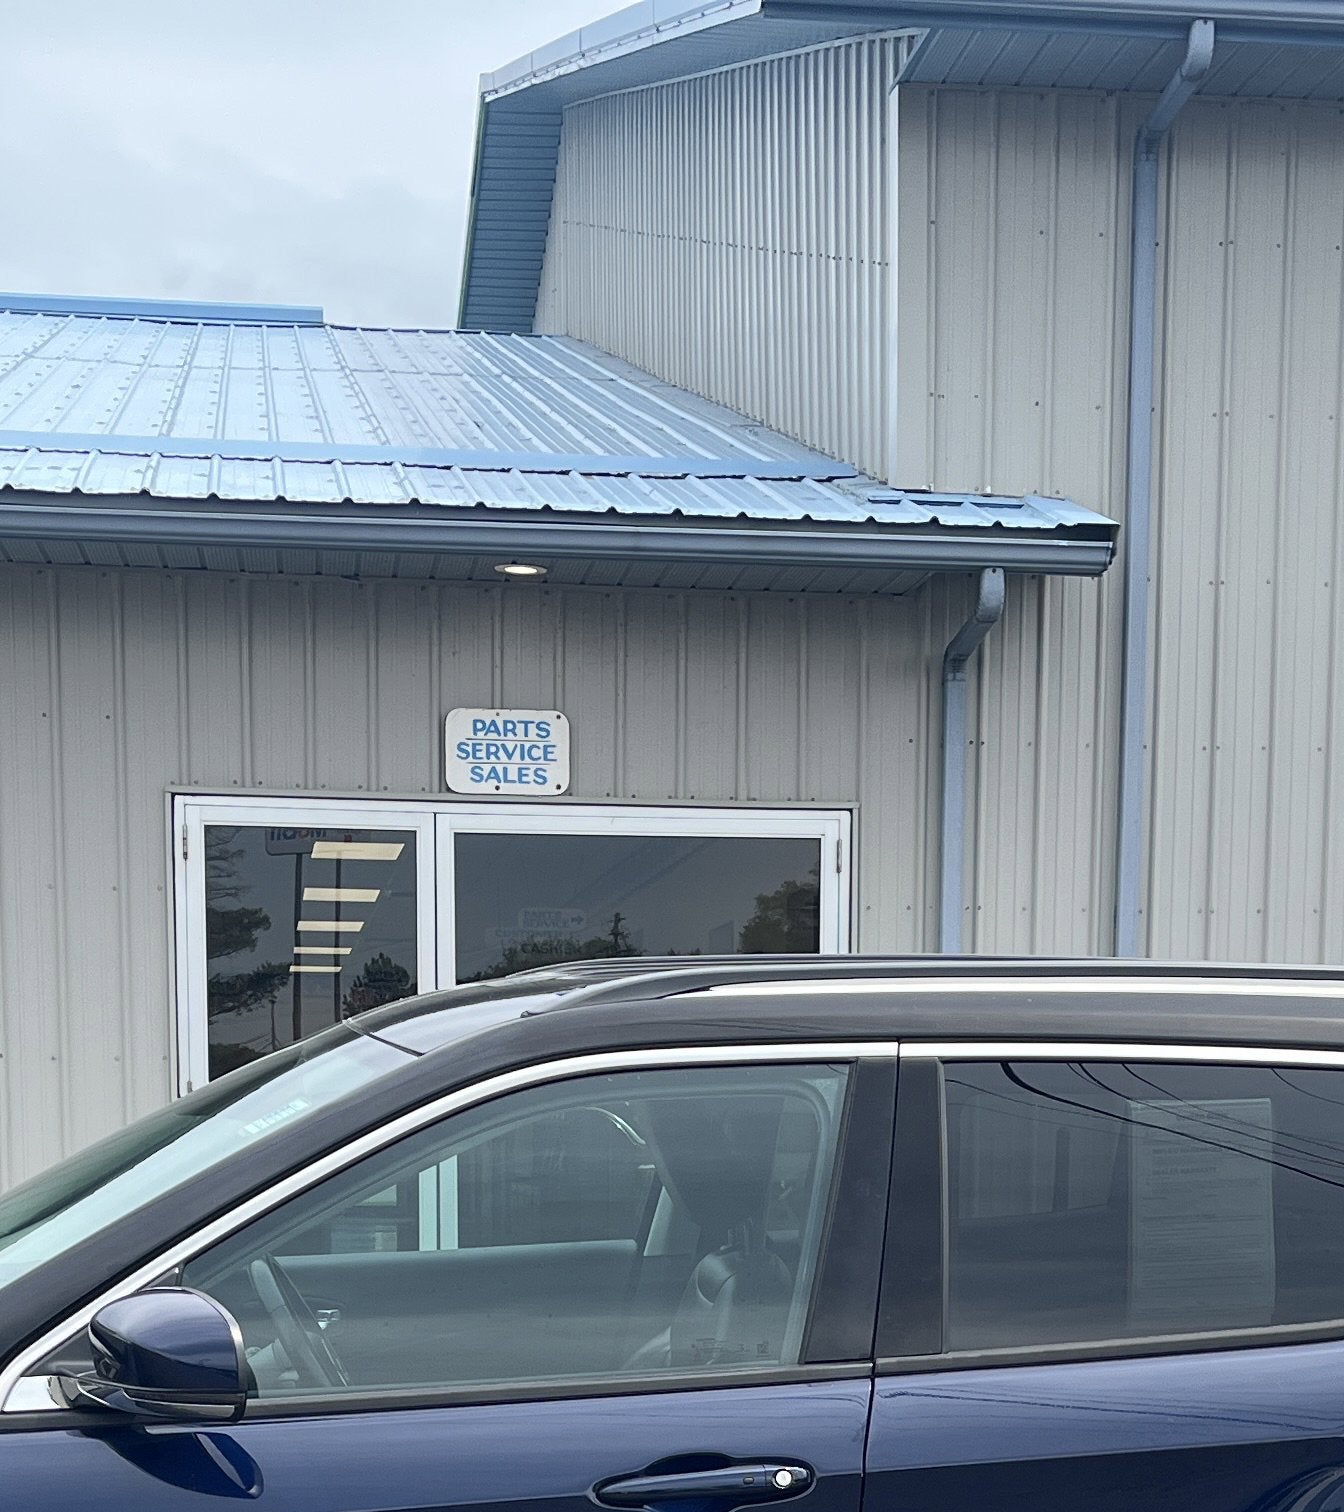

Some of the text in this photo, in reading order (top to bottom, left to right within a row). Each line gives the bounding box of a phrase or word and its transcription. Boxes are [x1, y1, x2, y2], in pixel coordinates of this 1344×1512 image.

[472, 718, 552, 739] PARTS
[456, 741, 558, 762] SERVICE
[469, 765, 548, 786] SALES
